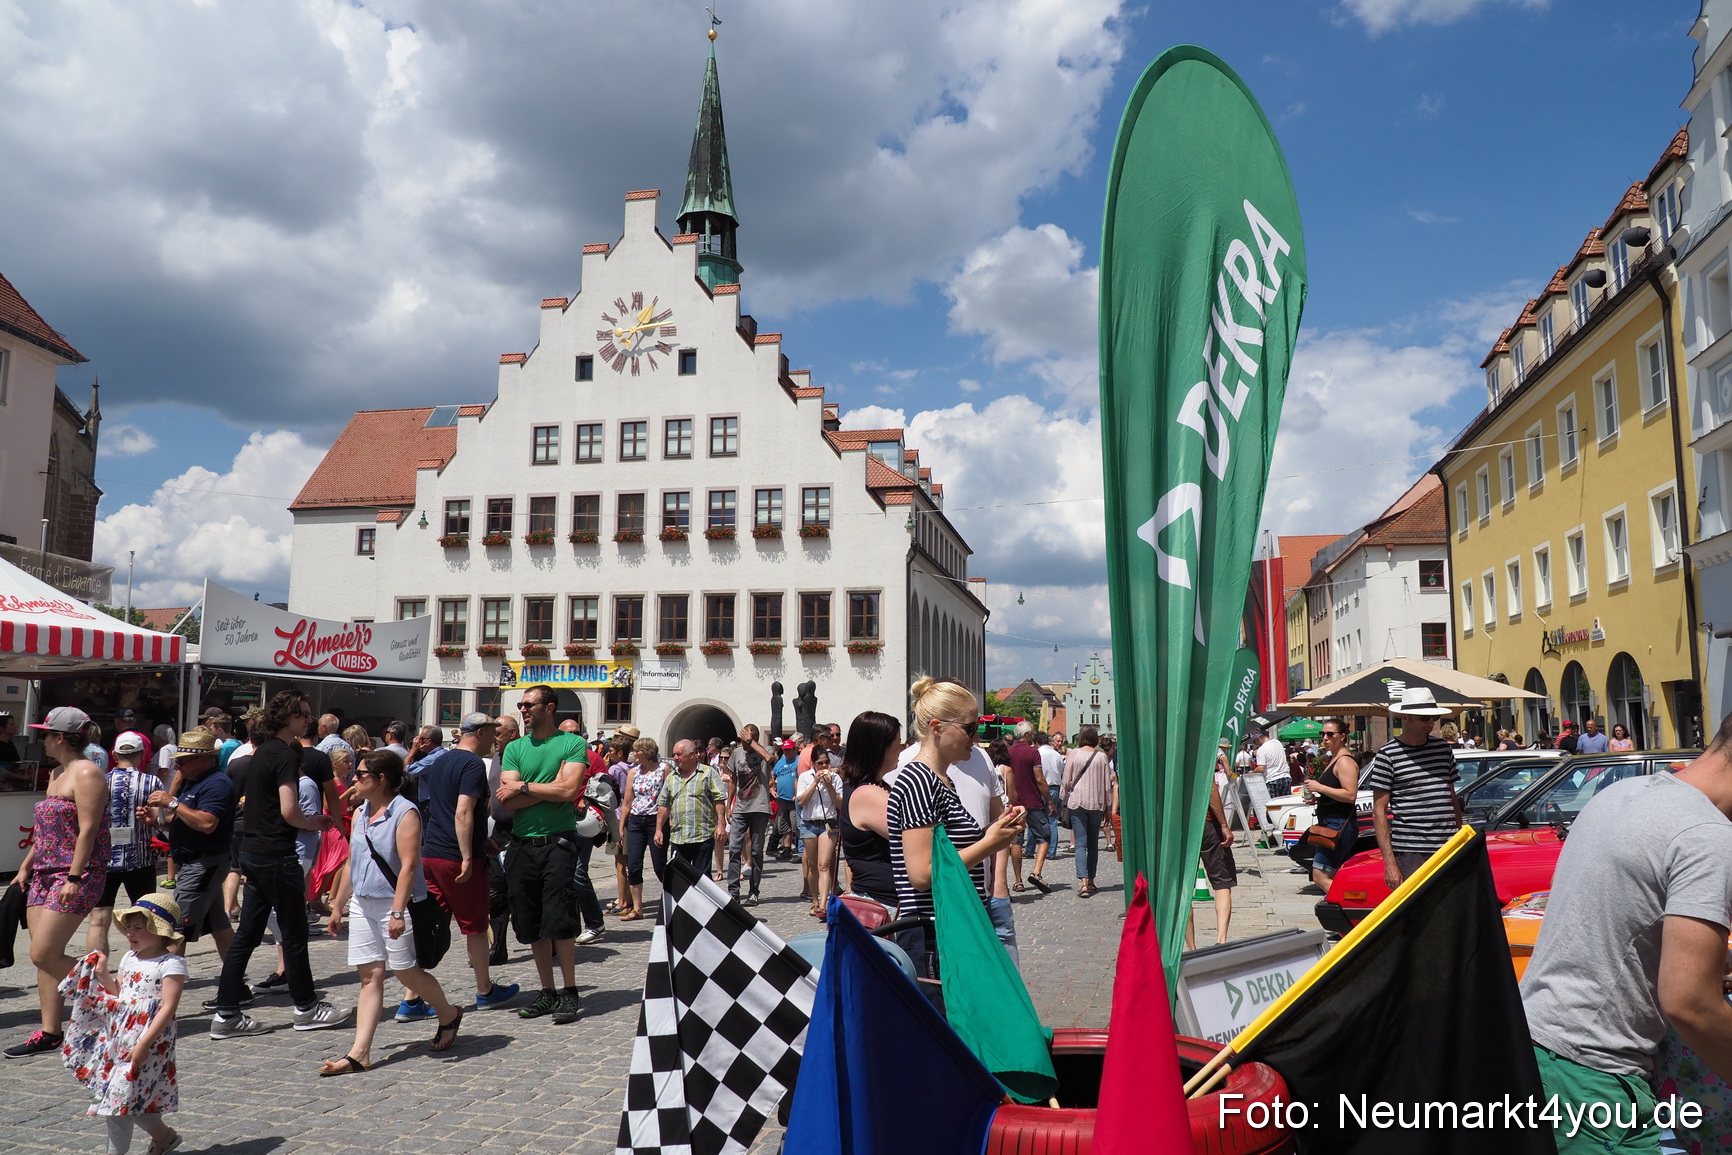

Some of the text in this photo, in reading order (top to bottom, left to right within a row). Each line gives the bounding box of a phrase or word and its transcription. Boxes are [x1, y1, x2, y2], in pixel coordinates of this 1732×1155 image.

[1177, 199, 1291, 481] DEKRA
[215, 615, 247, 632] Seit über
[224, 629, 259, 646] 50 Jahren
[273, 618, 373, 670] Lehmeier's
[336, 653, 373, 670] IMBISS
[519, 664, 609, 683] ANMELDUNG
[642, 670, 680, 679] Information
[1233, 667, 1258, 715] DEKRA
[1245, 969, 1295, 1006] DEKRA
